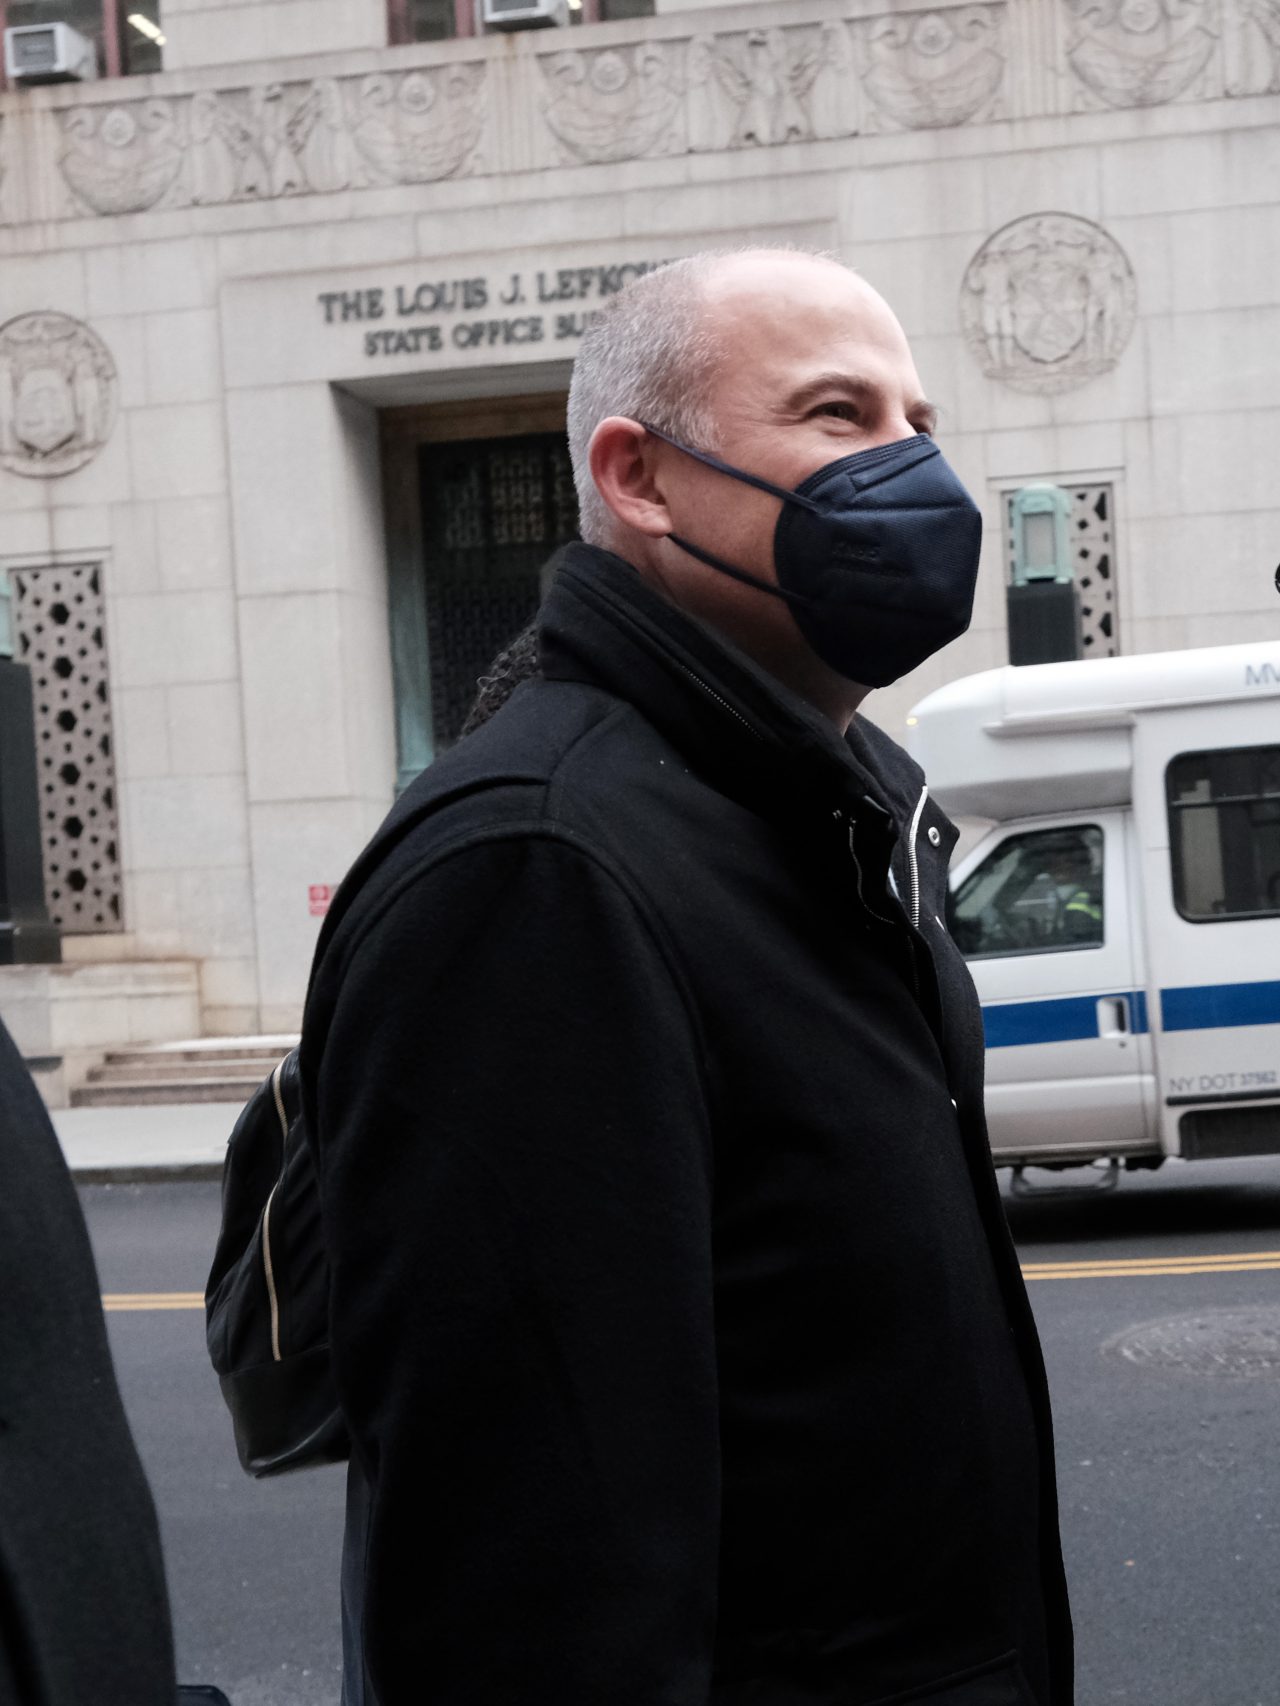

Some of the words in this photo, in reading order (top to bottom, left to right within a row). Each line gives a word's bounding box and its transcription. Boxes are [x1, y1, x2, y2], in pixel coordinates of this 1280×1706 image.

[317, 288, 384, 323] THE
[397, 278, 489, 316] LOUIS
[500, 274, 526, 304] J.
[364, 324, 443, 357] STATE
[452, 315, 545, 348] OFFICE
[1169, 1076, 1194, 1091] NY
[1199, 1072, 1238, 1091] DOT
